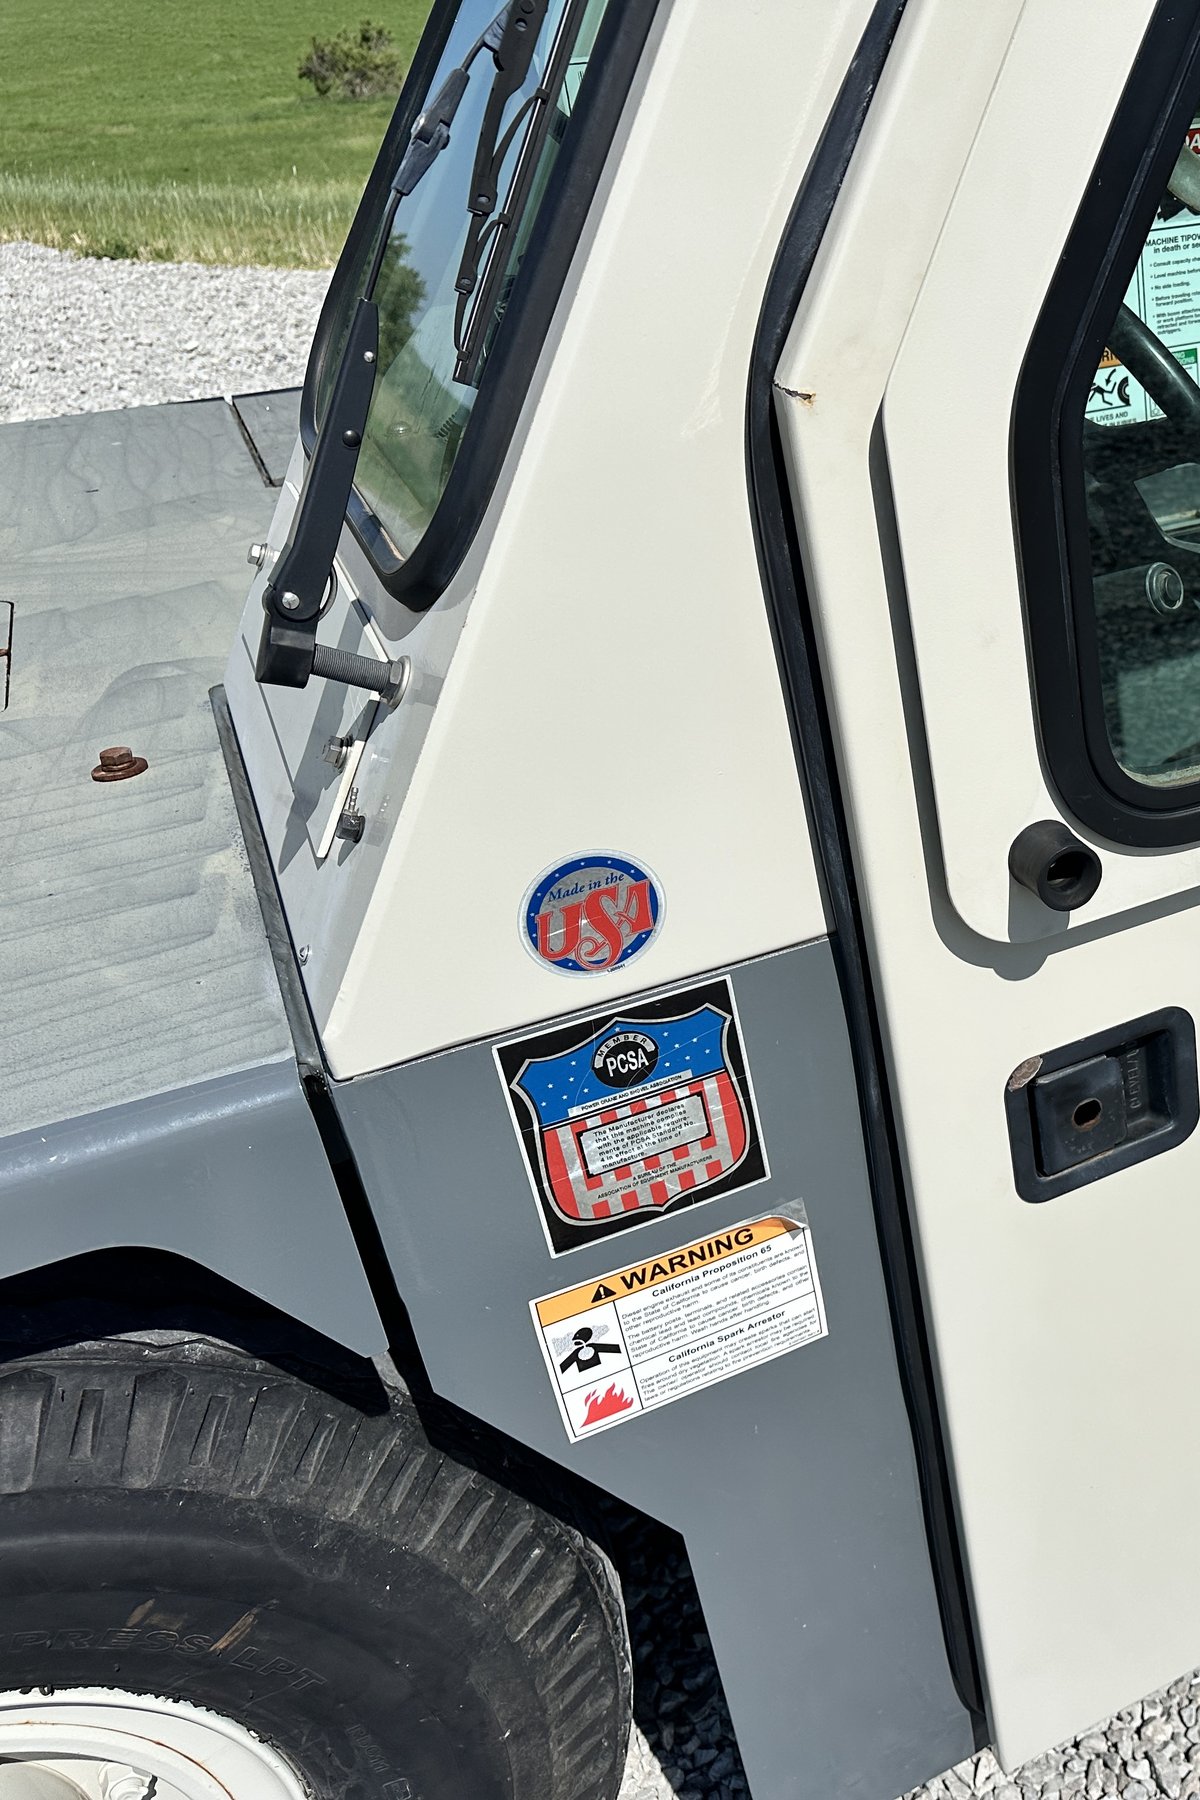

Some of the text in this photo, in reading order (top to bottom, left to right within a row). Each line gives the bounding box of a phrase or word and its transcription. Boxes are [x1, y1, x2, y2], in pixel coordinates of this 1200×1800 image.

[1145, 236, 1178, 247] MACHINE
[1161, 243, 1180, 252] death
[1096, 414, 1113, 422] LIVES
[546, 869, 624, 903] Made in the
[535, 879, 655, 971] USA
[597, 1034, 647, 1057] MEMBER
[606, 1046, 648, 1077] PCSA
[581, 1101, 599, 1111] POWER
[649, 1074, 681, 1088] ASSOCIATION
[593, 1102, 684, 1137] The Manufacturer declares
[595, 1134, 609, 1143] that
[611, 1129, 624, 1138] this
[625, 1119, 654, 1133] machine
[596, 1141, 611, 1150] with
[626, 1124, 661, 1141] applicable
[598, 1145, 620, 1156] ments
[630, 1135, 650, 1145] PCSA
[652, 1124, 682, 1138] Standard
[683, 1119, 695, 1127] No.
[615, 1147, 634, 1157] effect
[644, 1139, 656, 1147] the
[658, 1134, 672, 1142] time
[597, 1183, 631, 1199] ASSOCIATION
[640, 1170, 668, 1184] EQUIPMENT
[669, 1154, 712, 1173] MANUFACTURERS
[602, 1150, 647, 1169] manufacture.
[637, 1168, 658, 1179] BUREAU
[621, 1227, 755, 1291] WARNING
[651, 1244, 772, 1297] California Proposition 65
[621, 1307, 641, 1319] Diesel
[642, 1299, 664, 1312] engine
[665, 1288, 689, 1302] exhaust
[690, 1283, 702, 1291] and
[704, 1277, 720, 1286] some
[737, 1255, 772, 1273] constituents
[784, 1243, 803, 1254] known
[631, 1314, 642, 1322] the
[644, 1307, 660, 1317] State
[670, 1291, 699, 1306] California
[710, 1281, 728, 1290] cause
[753, 1264, 767, 1273] birth
[793, 1249, 804, 1257] and
[624, 1321, 640, 1331] other
[642, 1306, 681, 1325] reproductive
[628, 1331, 639, 1340] The
[641, 1322, 662, 1335] battery
[715, 1296, 727, 1304] and
[728, 1287, 749, 1299] related
[751, 1273, 785, 1290] accessories
[786, 1264, 807, 1276] contain
[668, 1309, 785, 1363] California Spark Arrestor
[0, 1627, 329, 1690] PRESS LPT
